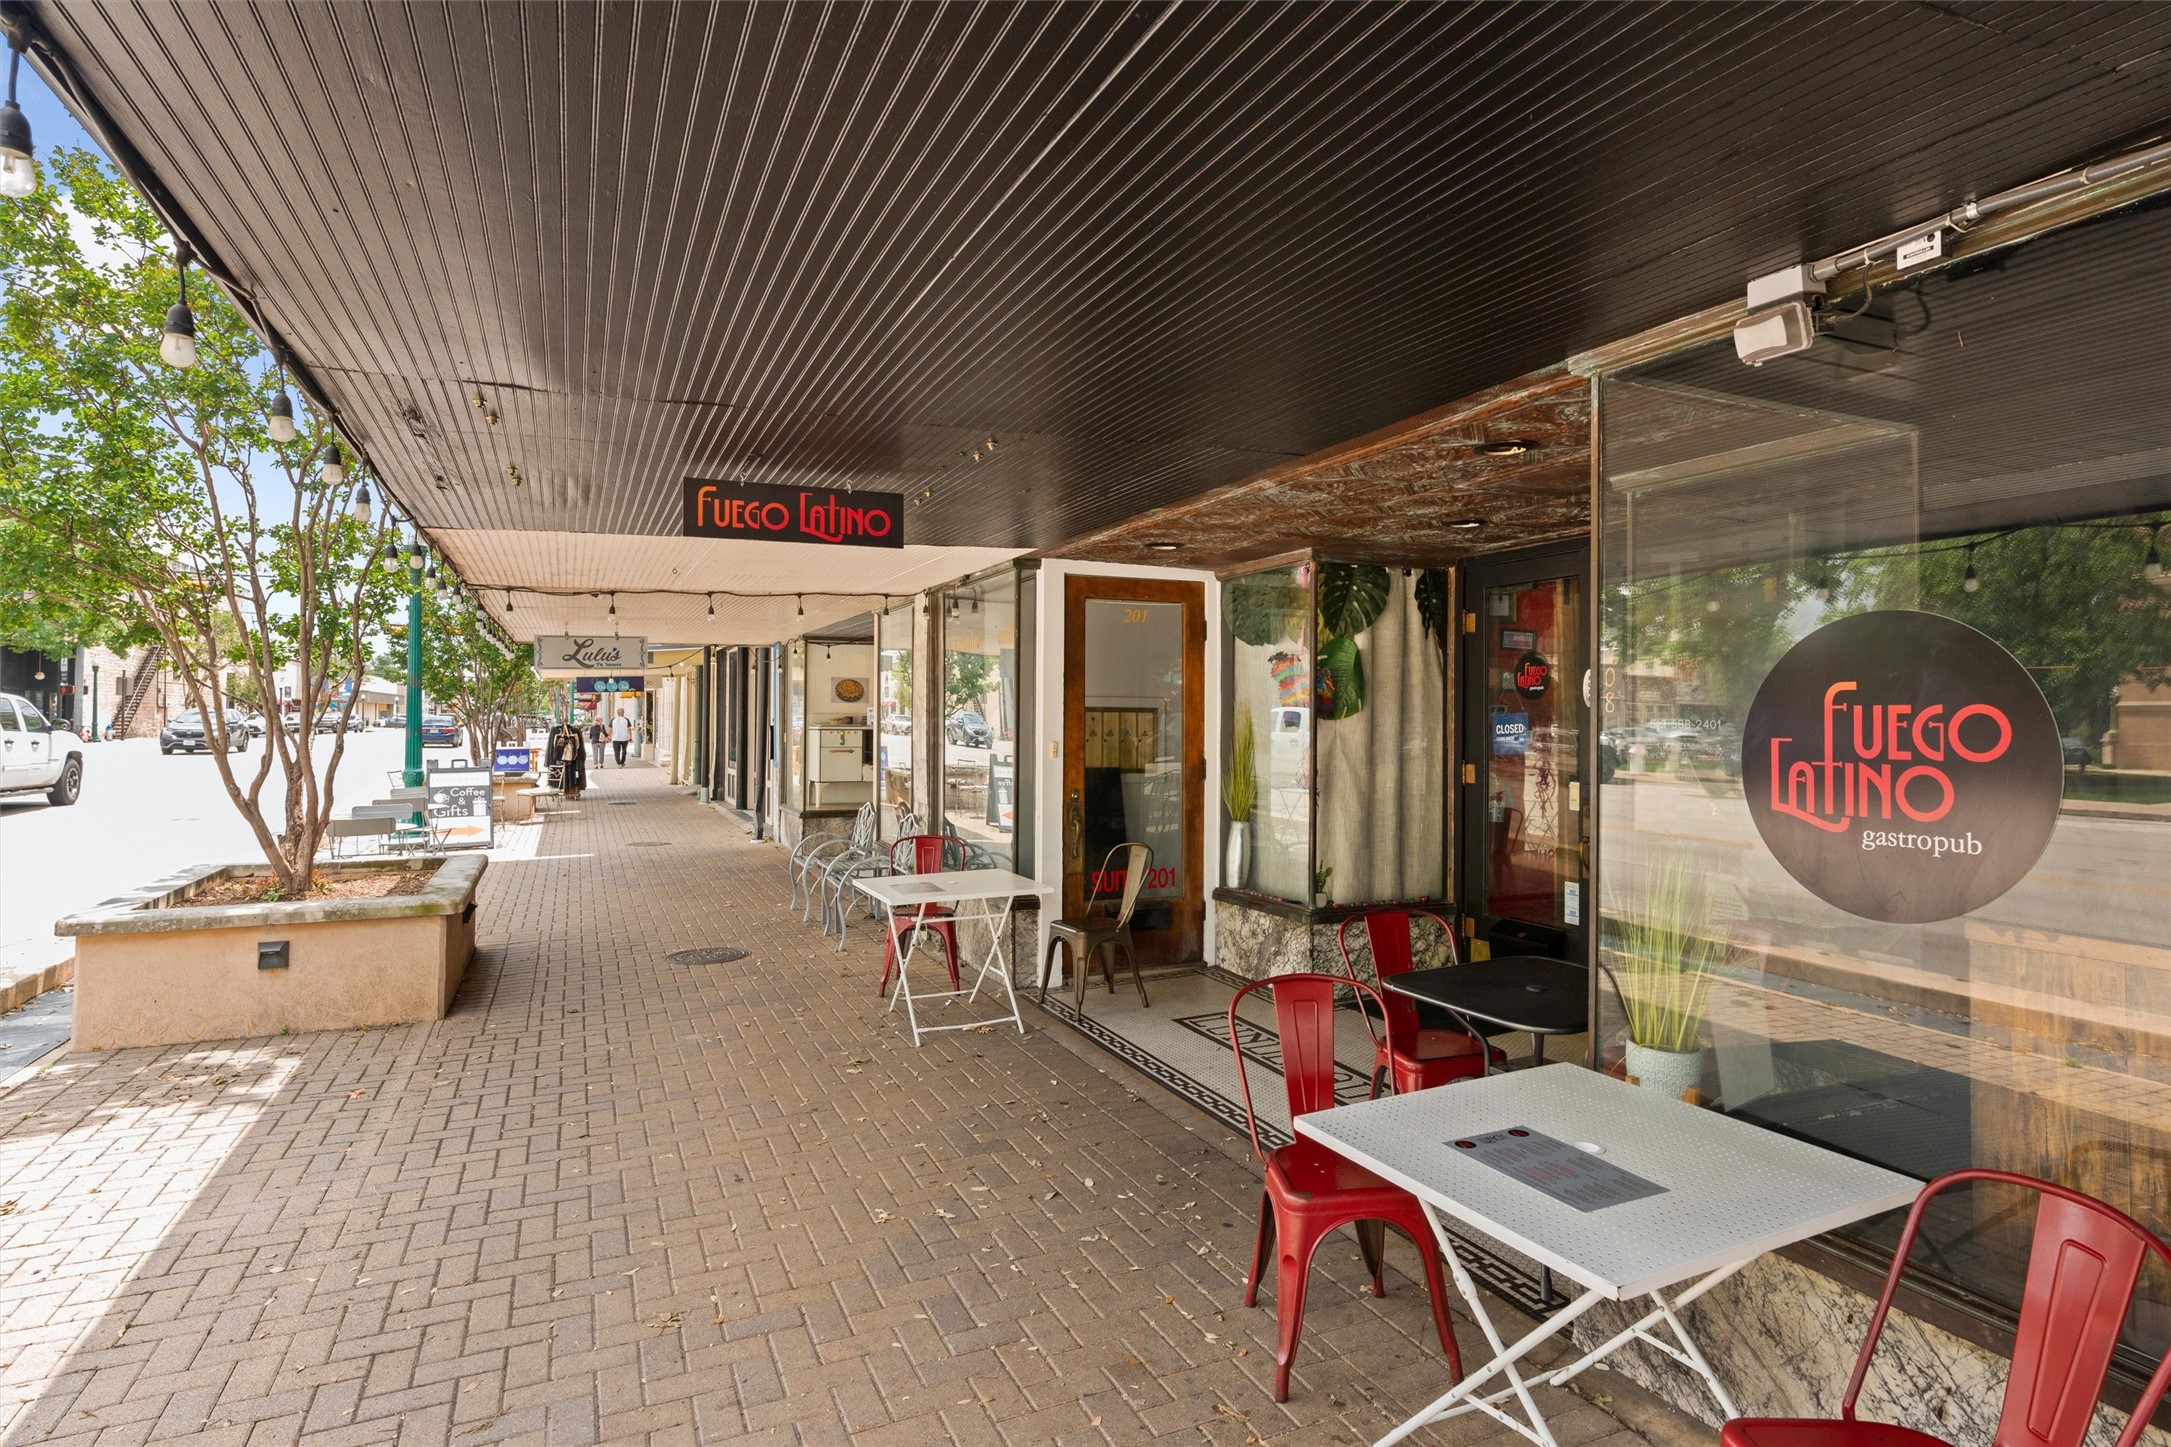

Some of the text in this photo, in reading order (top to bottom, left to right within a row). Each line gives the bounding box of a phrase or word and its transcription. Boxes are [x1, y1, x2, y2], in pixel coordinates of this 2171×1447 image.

[697, 485, 892, 543] FUEGO LATINO
[1122, 608, 1149, 624] 201
[562, 638, 622, 669] Lulu's
[1495, 723, 1524, 735] CLOSED
[1824, 681, 2012, 763] FUEGO
[450, 787, 486, 797] Coffee
[1771, 737, 1955, 833] LATINO
[433, 804, 469, 818] Gifts
[458, 797, 466, 805] &
[1861, 830, 1983, 858] gastropub
[1090, 866, 1176, 893] SUIT 201
